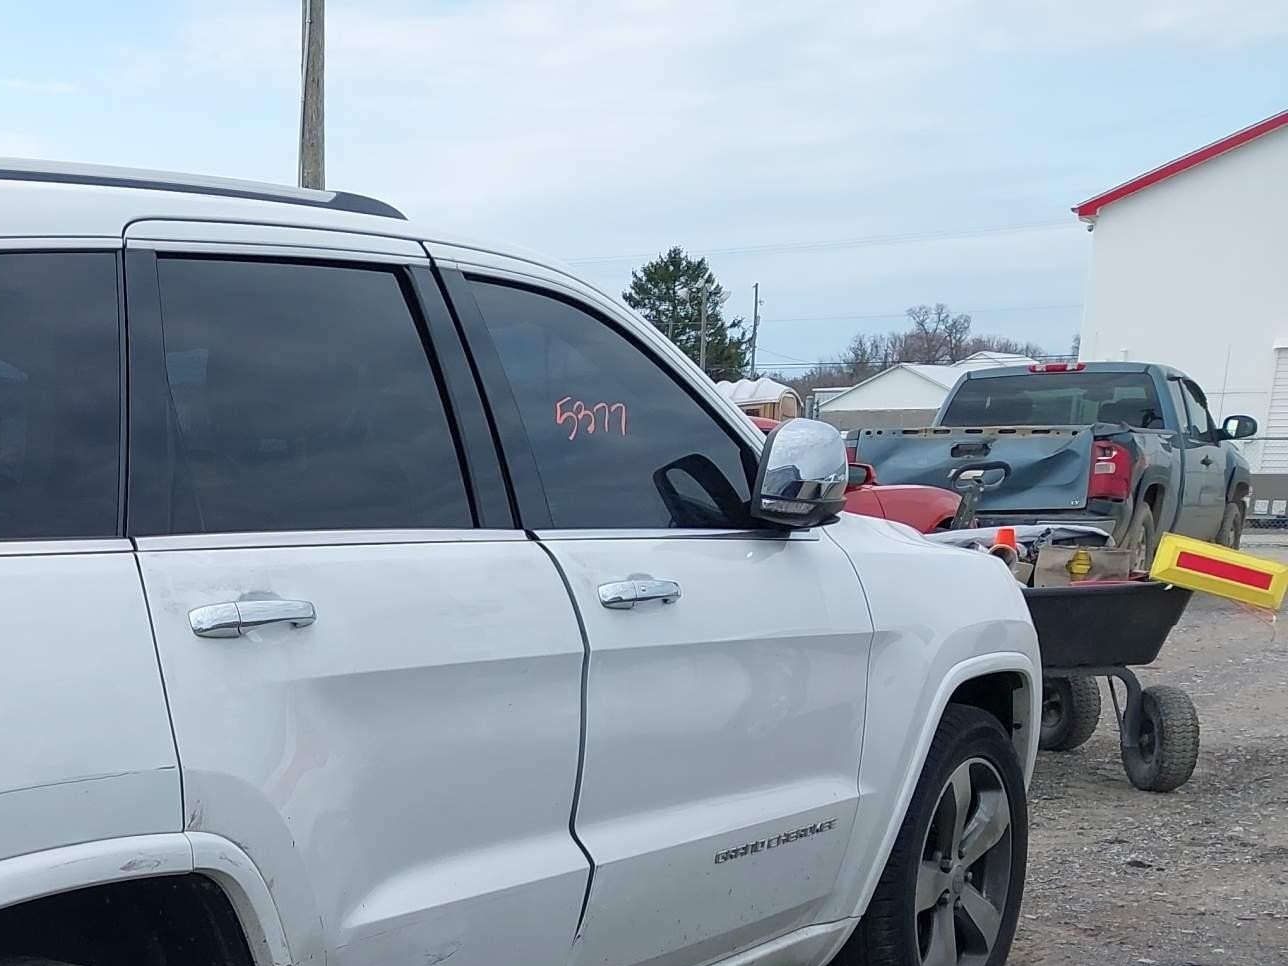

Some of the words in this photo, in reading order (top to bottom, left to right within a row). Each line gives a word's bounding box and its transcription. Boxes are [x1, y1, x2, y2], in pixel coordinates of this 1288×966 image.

[555, 396, 627, 441] 5377
[715, 837, 766, 865] GRAND
[767, 815, 840, 850] CHEROKEE
